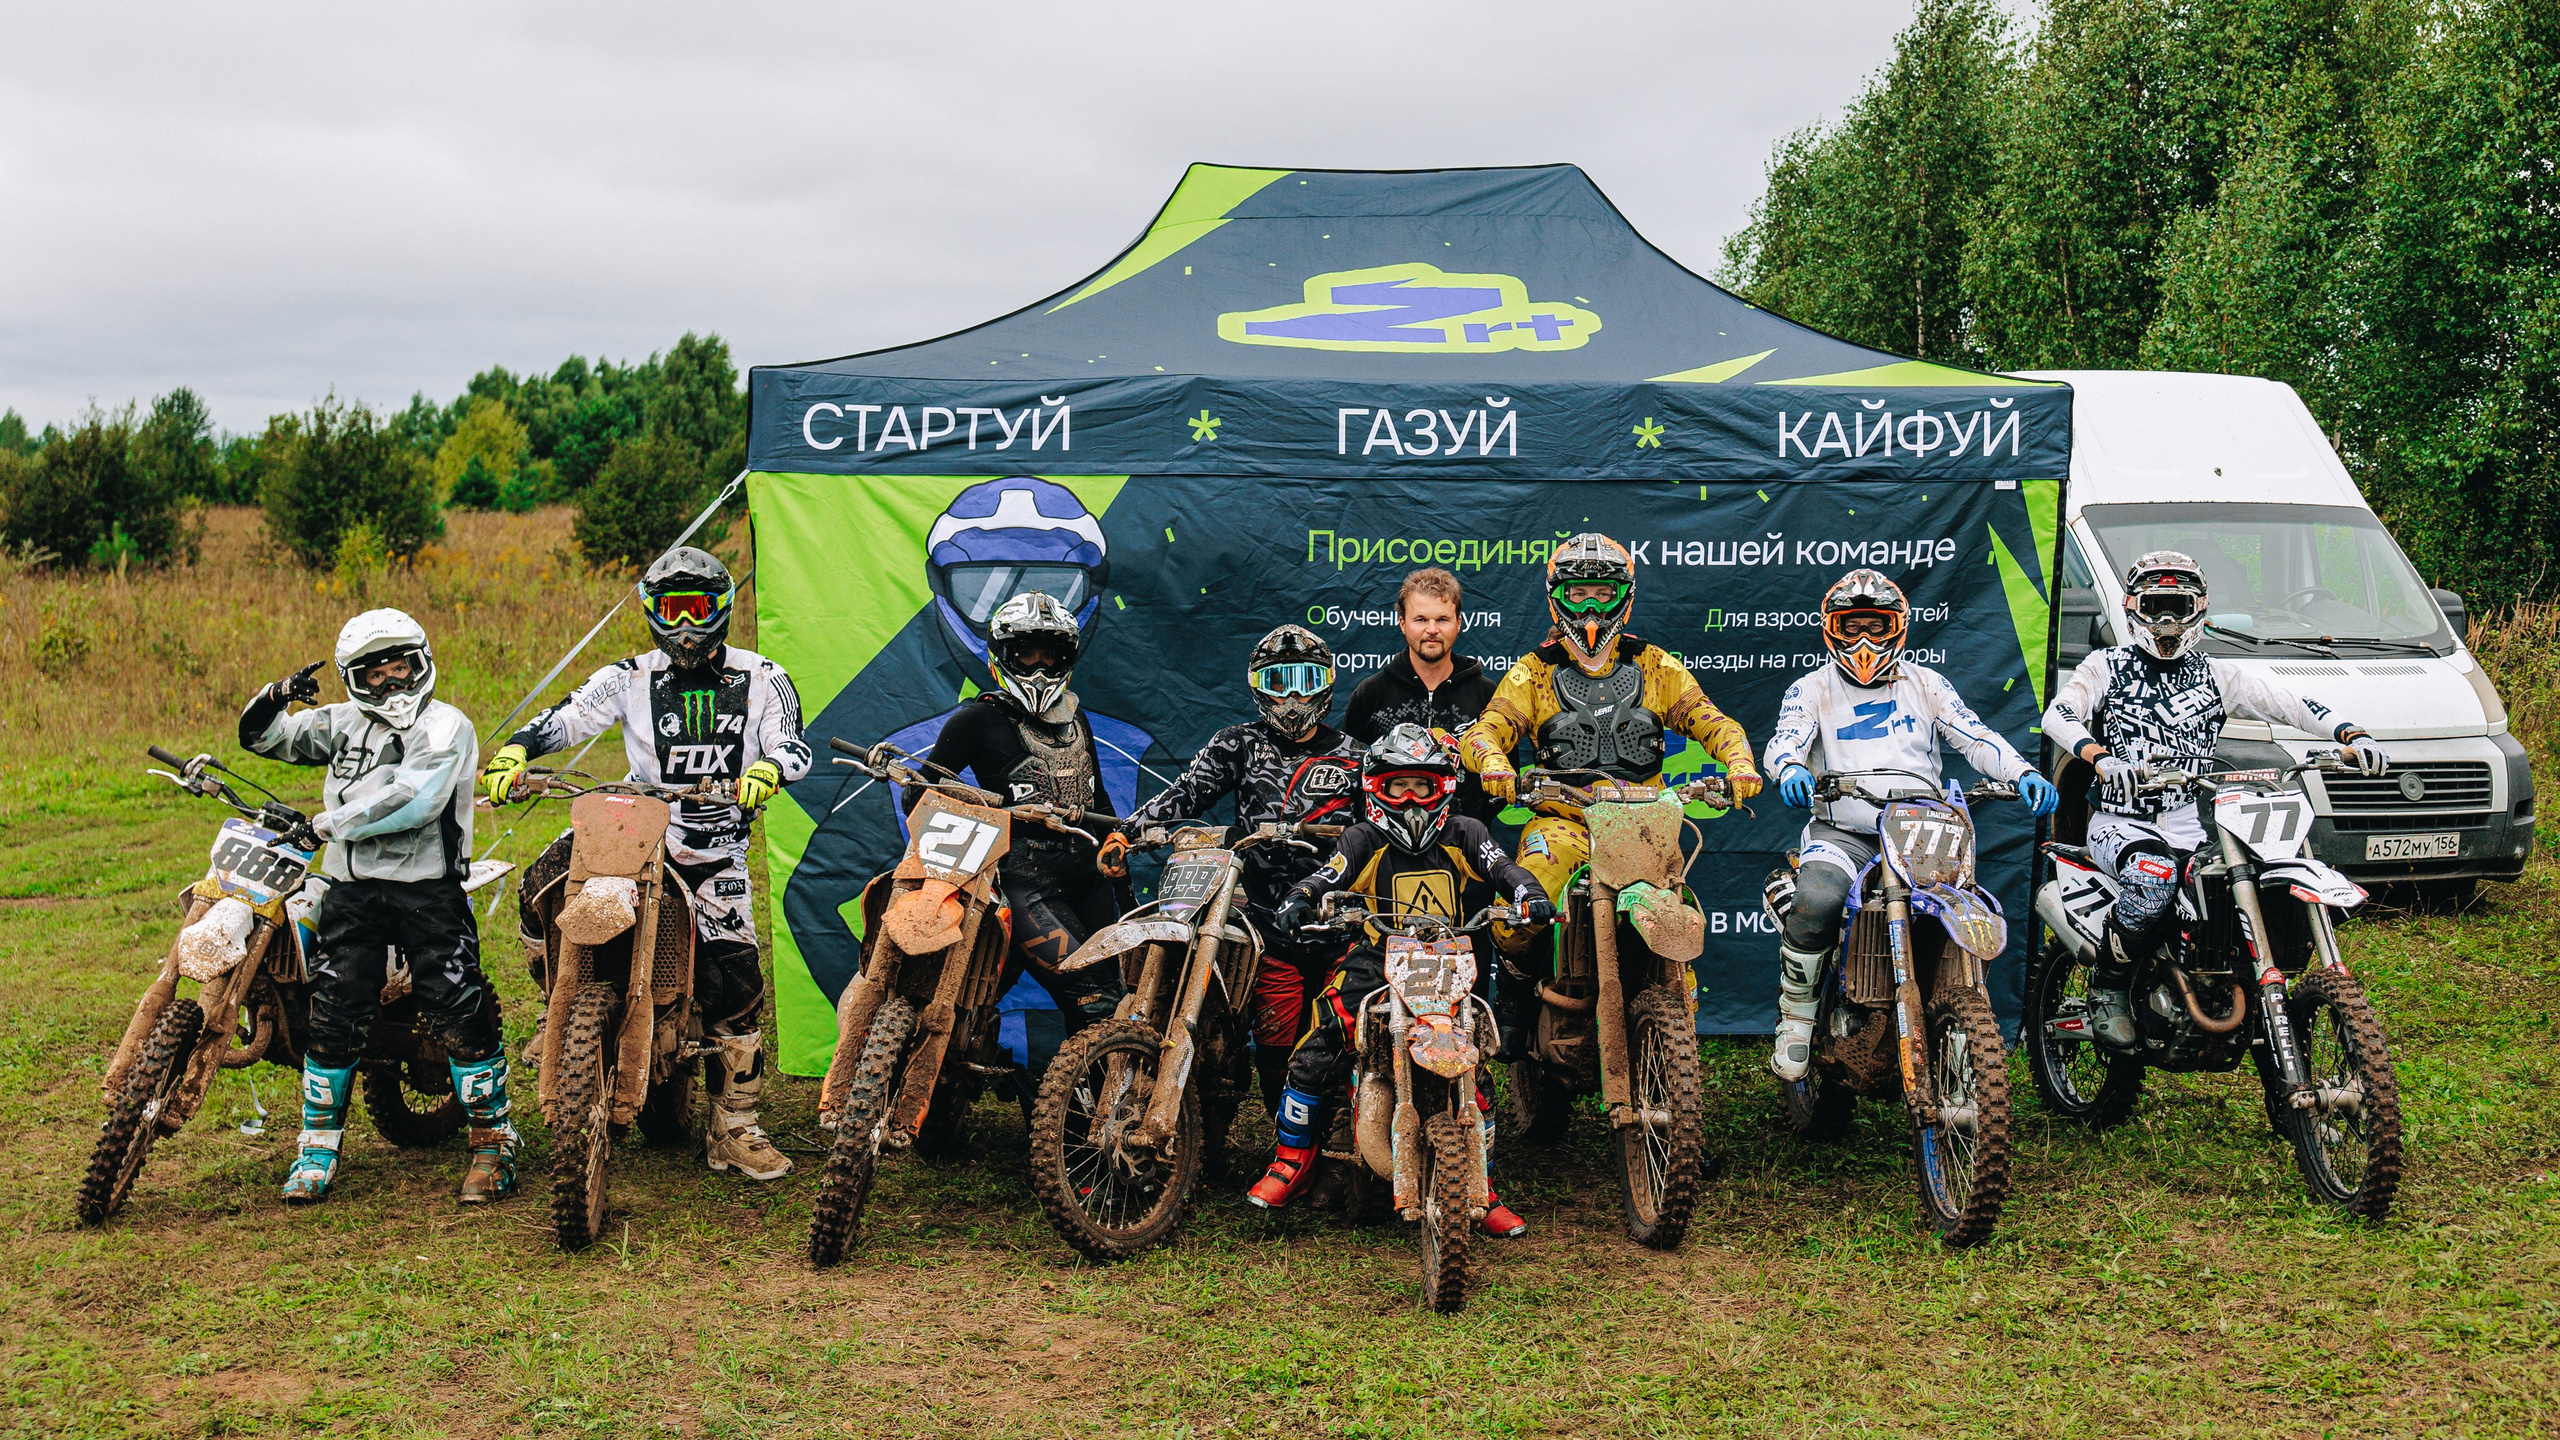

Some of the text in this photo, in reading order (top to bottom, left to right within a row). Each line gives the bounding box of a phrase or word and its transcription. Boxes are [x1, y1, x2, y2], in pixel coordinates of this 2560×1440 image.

[803, 396, 2019, 457] СТАРТУЙ ГАЗУЙ КАЙФУЙ
[1308, 530, 1955, 571] Присоединяй к нашей команде
[1307, 605, 1501, 632] Обучени уля
[1705, 602, 1949, 632] Для взрос тей
[1331, 653, 1521, 673] орти ман
[1760, 654, 1786, 669] на
[1792, 652, 1832, 668] гон
[1902, 648, 1946, 666] оры
[716, 714, 745, 734] 74
[1594, 705, 1614, 717] LEATT
[666, 744, 735, 775] FOX
[2225, 772, 2279, 782] RENTHAL
[2241, 802, 2301, 844] 77
[919, 811, 1000, 874] 21
[1900, 820, 1965, 858] 777
[2434, 836, 2457, 849] 156
[213, 837, 305, 893] 888
[2142, 863, 2168, 876] LEATT
[2061, 876, 2116, 917] 77
[2270, 993, 2294, 1071] PIRELLI
